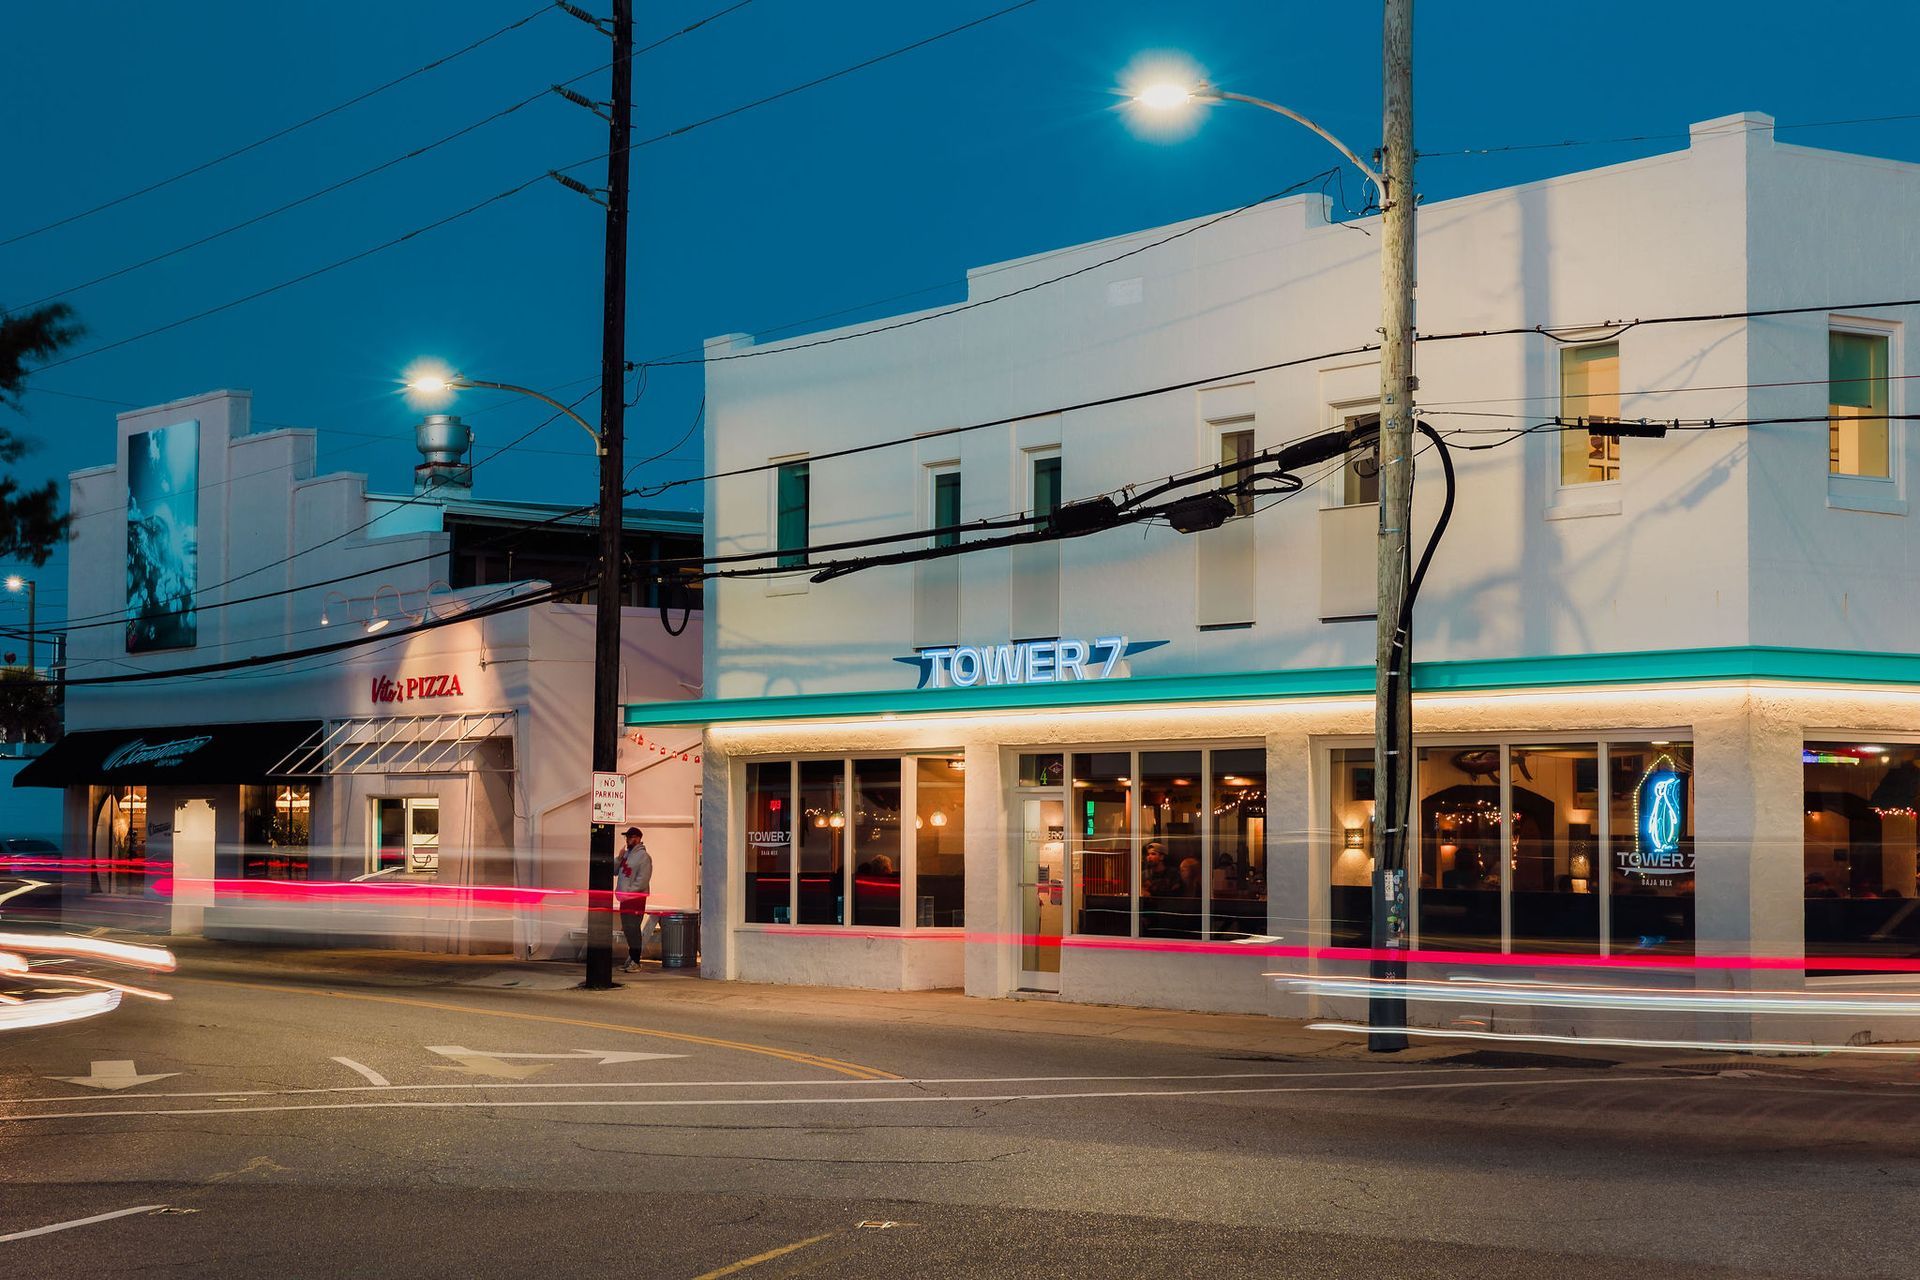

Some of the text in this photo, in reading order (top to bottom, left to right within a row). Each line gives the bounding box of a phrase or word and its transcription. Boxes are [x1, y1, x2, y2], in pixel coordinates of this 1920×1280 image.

[922, 636, 1128, 688] TOWER 7
[371, 674, 464, 704] Vito's PIZZA
[1040, 767, 1048, 785] 4
[604, 779, 616, 788] NO
[595, 790, 624, 800] PARKING
[748, 831, 792, 842] TOWER 7
[1616, 851, 1696, 868] TOWER 7
[1659, 879, 1673, 887] MEX
